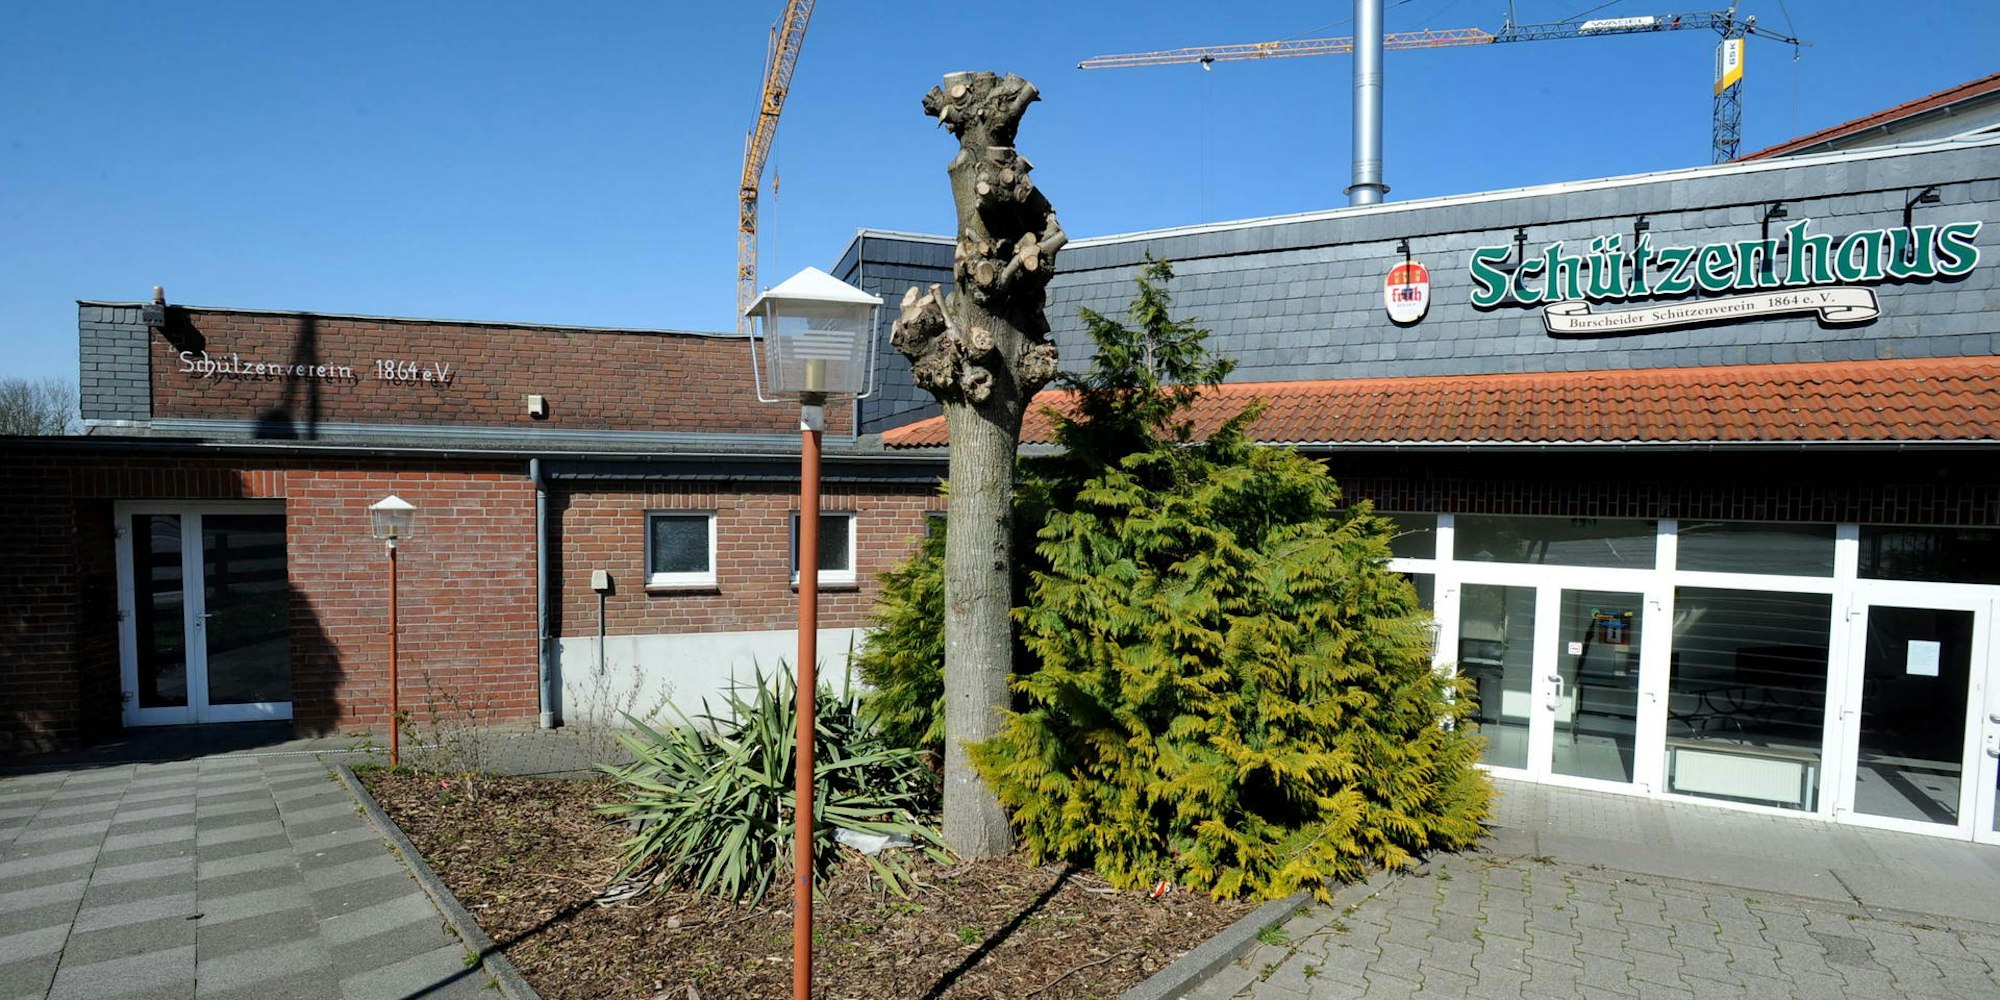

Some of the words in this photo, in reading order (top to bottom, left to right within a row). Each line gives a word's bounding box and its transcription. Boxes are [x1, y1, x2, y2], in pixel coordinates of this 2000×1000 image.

[1469, 218, 1982, 306] Schützenhaus
[1569, 314, 1644, 328] Burscheider
[1652, 302, 1755, 321] Schützenverein
[1768, 295, 1799, 308] 1864
[1802, 294, 1815, 305] e.
[1819, 292, 1836, 303] V.
[179, 350, 351, 378] Schützenverein
[375, 359, 418, 380] 1864
